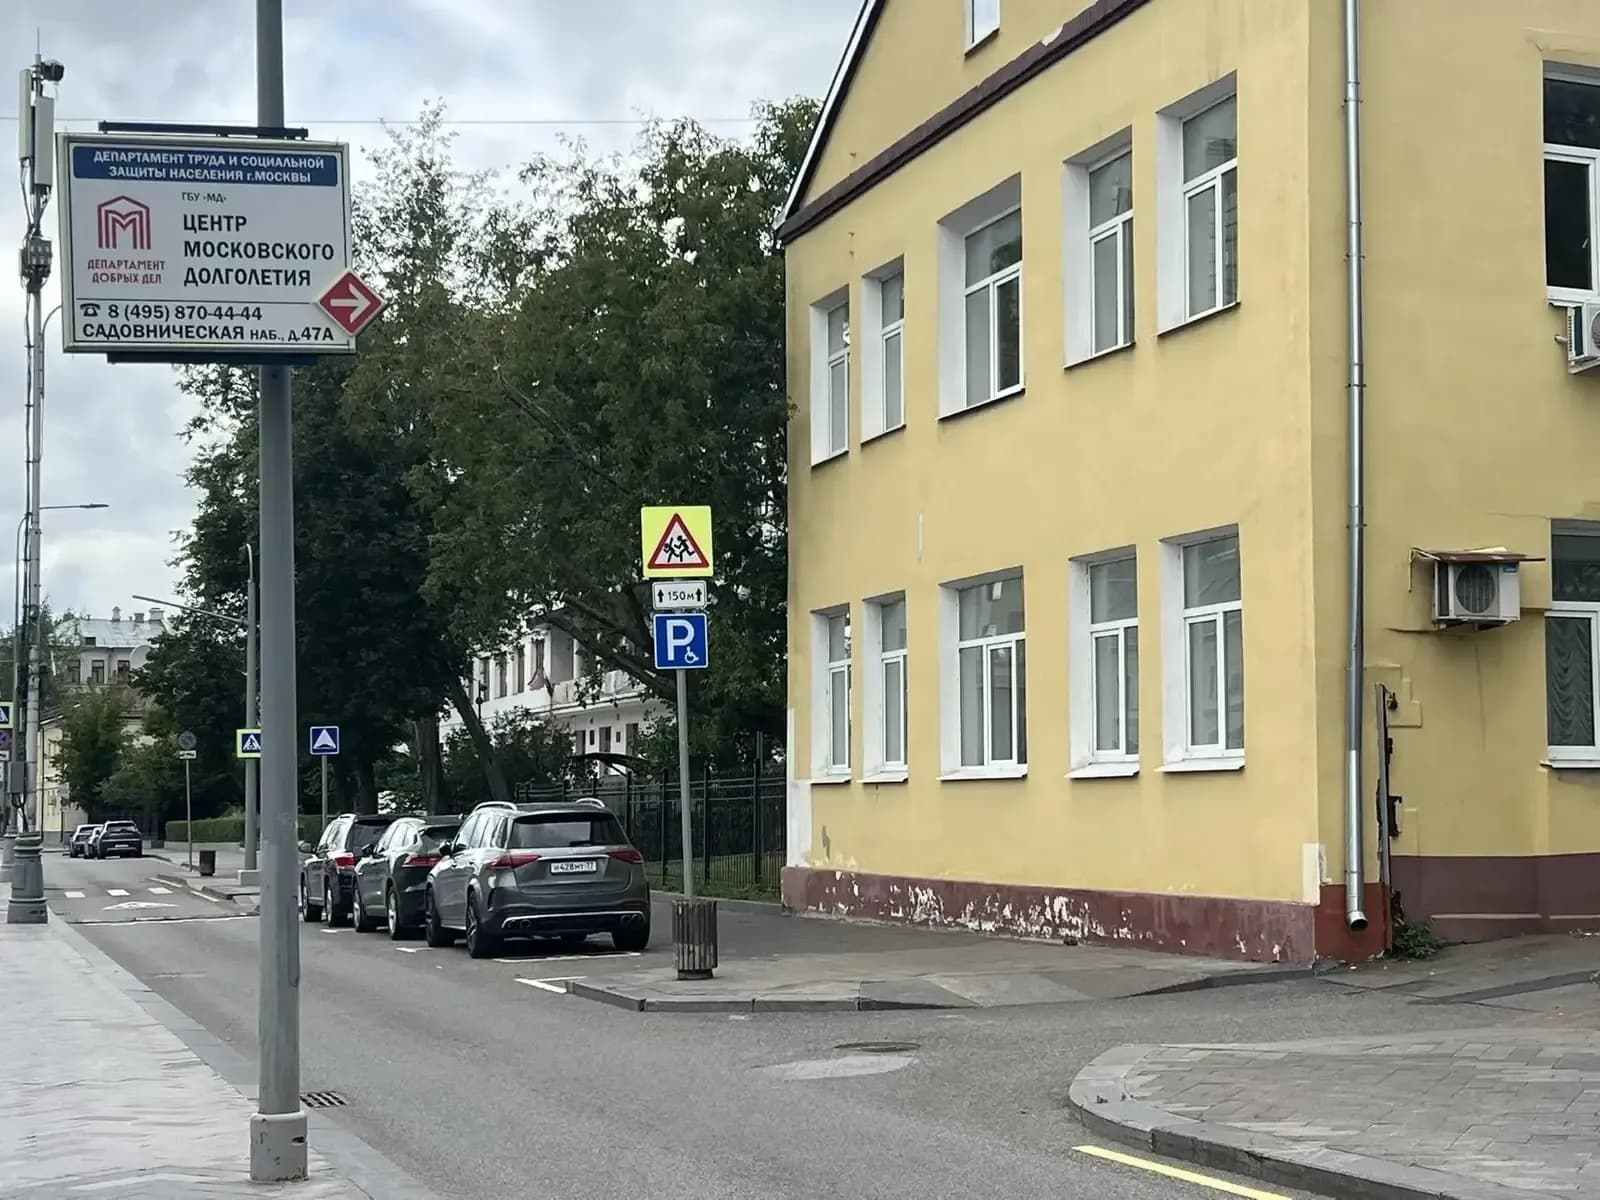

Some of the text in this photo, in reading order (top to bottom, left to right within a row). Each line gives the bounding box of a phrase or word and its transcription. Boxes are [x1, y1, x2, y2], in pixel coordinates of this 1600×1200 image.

[94, 151, 324, 169] ДЕПАРТАМЕНТ ТРУДА И СОЦИАЛЬНОЙ
[108, 166, 311, 183] ЗАЩИТЫ НАСЕЛЕНИЯ г.МОСКВЫ
[181, 191, 200, 202] ГБУ
[183, 213, 247, 234] ЦЕНТР
[184, 240, 335, 260] МОСКОВСКОГО
[87, 258, 166, 271] ДЕПАРТАМЕНТ
[92, 272, 162, 285] ДОБРЫХ ДЕЛ
[184, 267, 311, 287] ДОЛГОЛЕТИЯ
[108, 304, 262, 322] 8 (495) 870-44-44
[82, 323, 244, 340] САДОВНИЧЕСКАЯ
[666, 619, 695, 661] P
